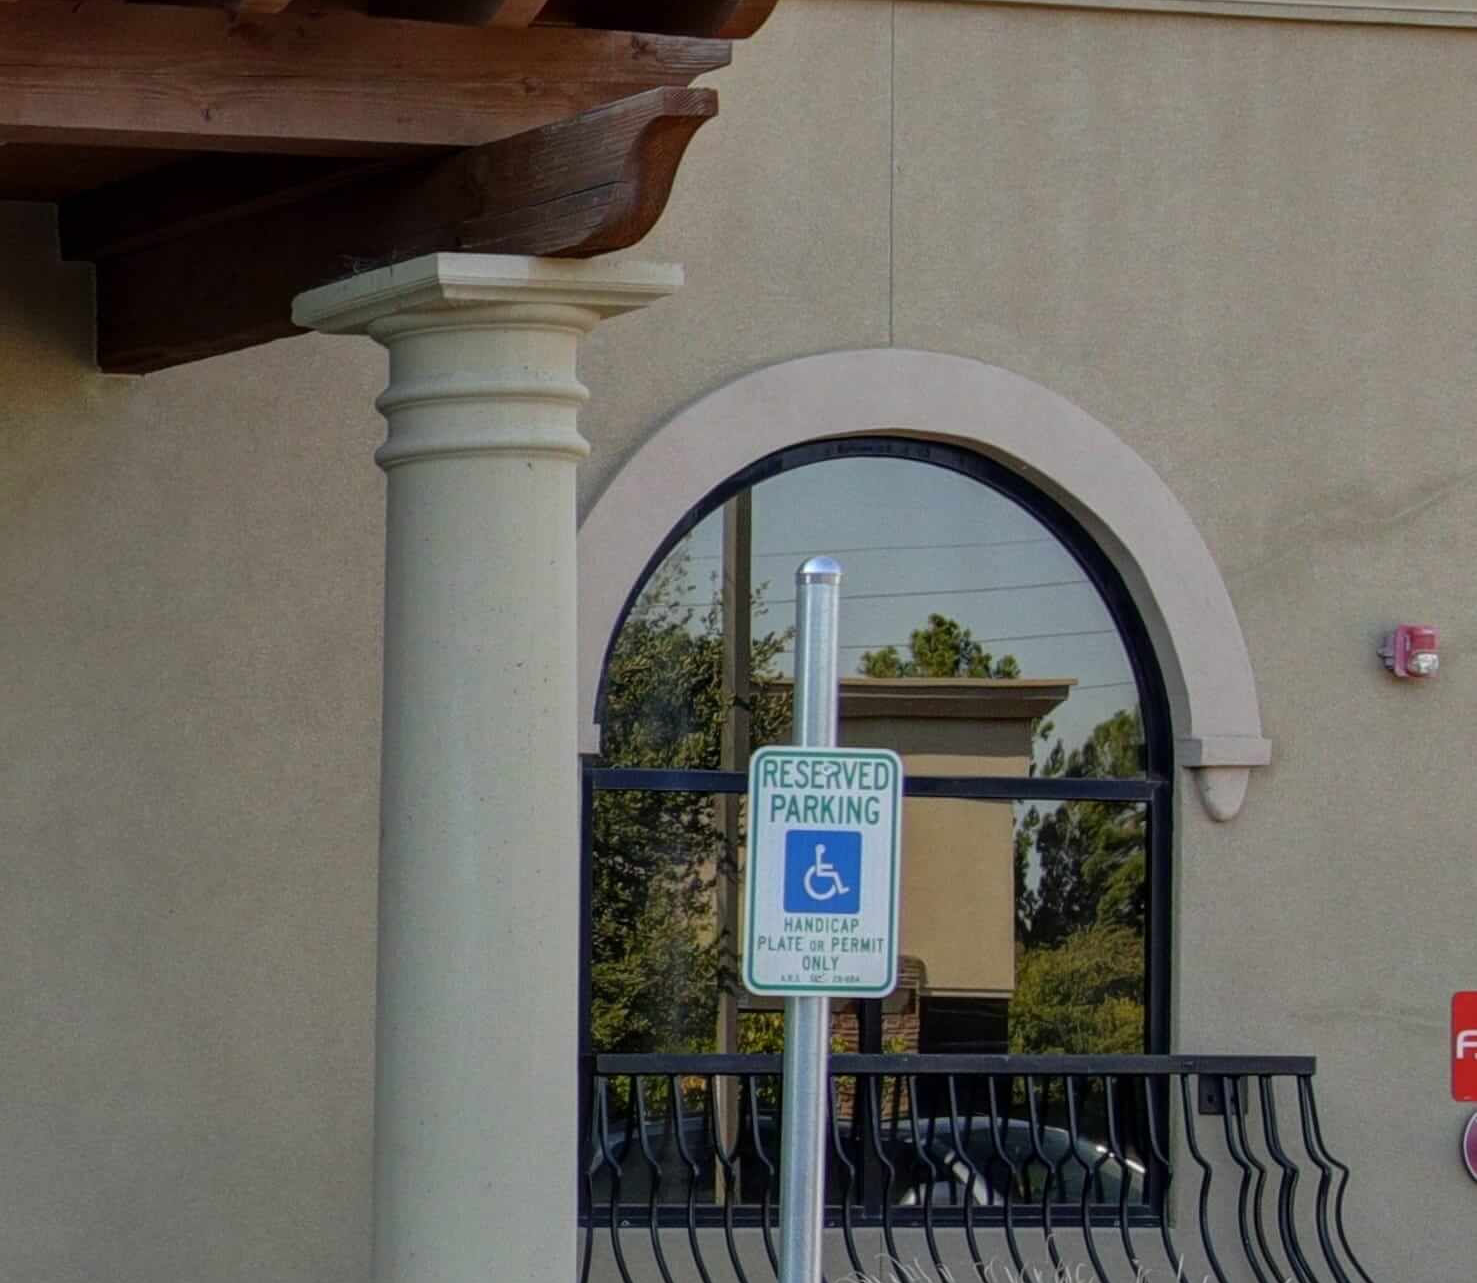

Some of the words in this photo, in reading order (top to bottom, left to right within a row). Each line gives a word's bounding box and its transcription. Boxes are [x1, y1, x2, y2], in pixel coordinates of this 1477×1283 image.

[762, 759, 889, 790] RESERVED
[770, 794, 880, 825] PARKING
[783, 917, 859, 932] HANDICAP
[758, 936, 803, 951] PLATE
[831, 937, 884, 953] PERMIT
[802, 955, 839, 971] ONLY
